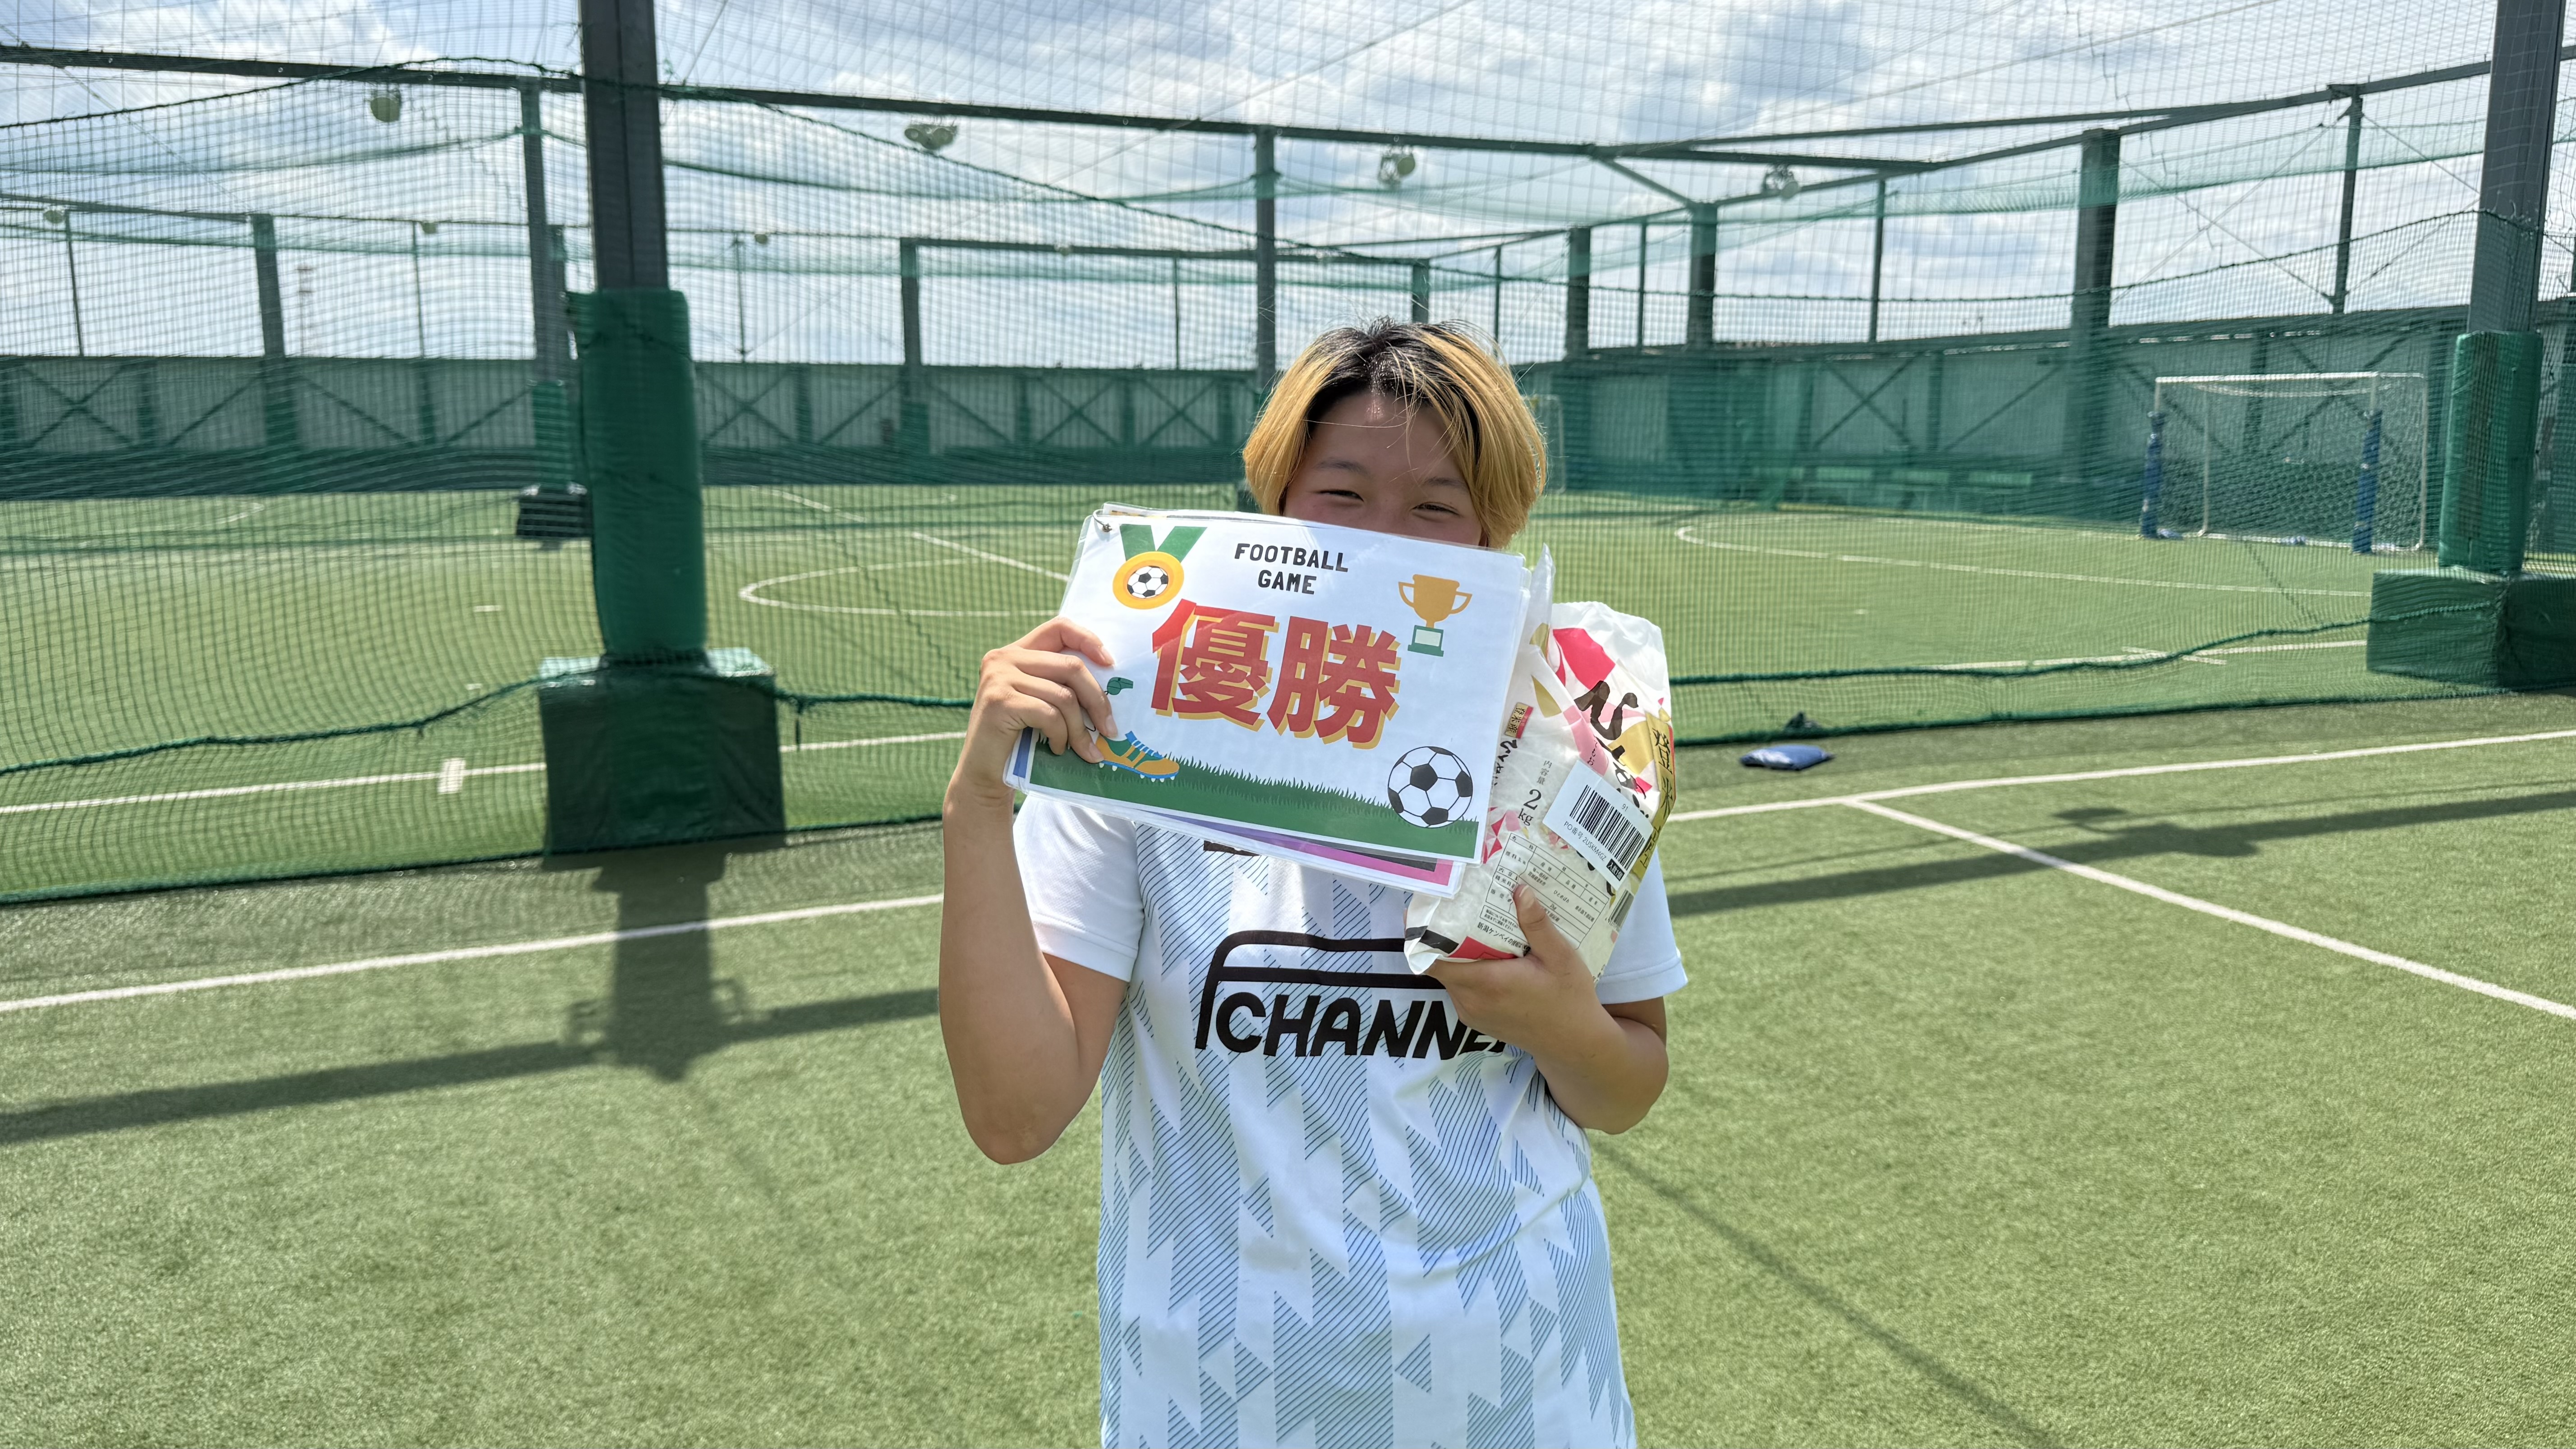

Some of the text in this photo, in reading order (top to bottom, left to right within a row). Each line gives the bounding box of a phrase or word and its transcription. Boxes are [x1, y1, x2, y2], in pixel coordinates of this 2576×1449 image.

[1234, 543, 1348, 572] FOOTBALL
[1258, 570, 1317, 595] GAME
[1151, 598, 1401, 750] 優勝
[1536, 760, 1552, 785] 内容量
[1523, 789, 1542, 811] 2
[1621, 804, 1628, 812] 91
[1518, 808, 1533, 826] kg
[1564, 821, 1583, 839] PO番号
